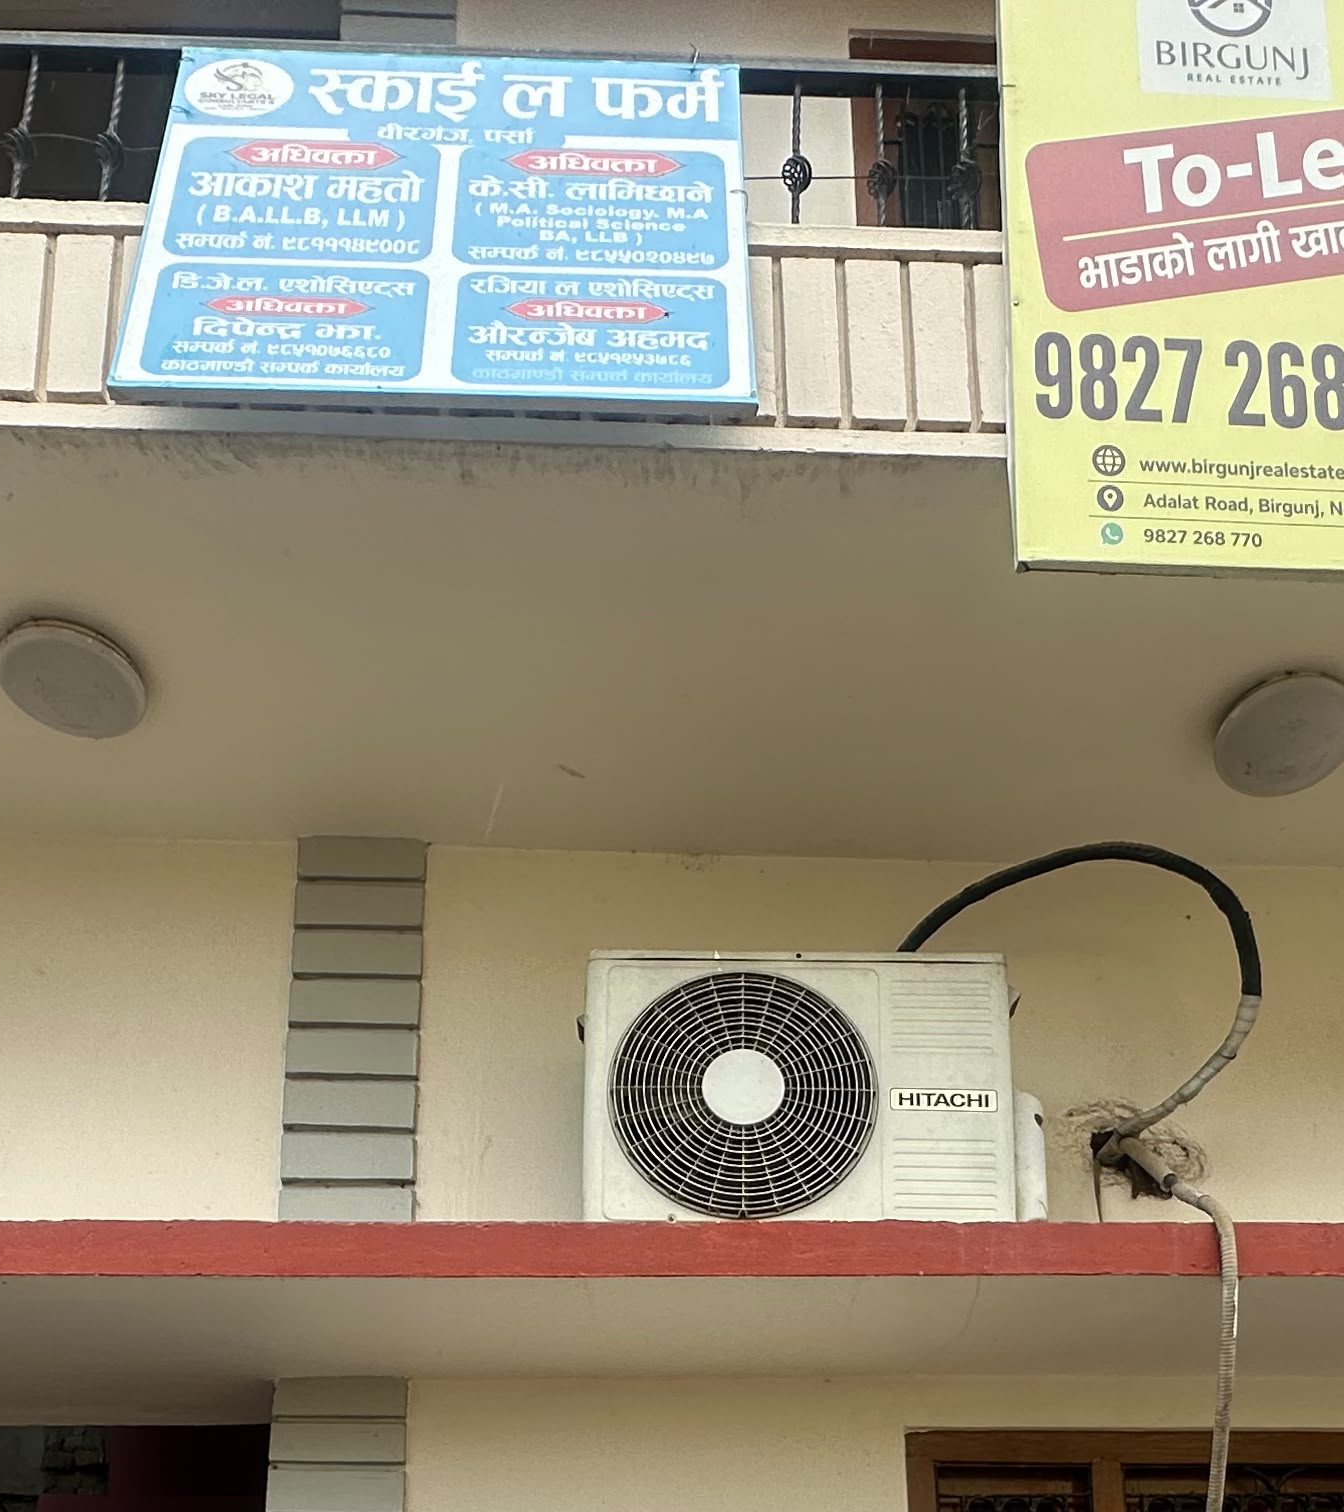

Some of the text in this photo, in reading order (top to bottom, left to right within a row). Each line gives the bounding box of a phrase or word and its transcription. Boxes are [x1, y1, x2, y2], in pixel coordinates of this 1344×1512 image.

[1155, 40, 1310, 81] BIRGUNJ
[1186, 72, 1282, 87] REAL ESTATE
[308, 61, 725, 123] स्काई ल फर्म
[250, 144, 380, 166] अधिवक्ता
[528, 153, 659, 174] अधिवक्ता
[188, 169, 426, 205] आकाश महतो
[337, 207, 390, 228] LLM
[495, 215, 688, 233] Political Science
[174, 230, 249, 250] सम्पर्क
[585, 230, 629, 244] LLB
[467, 242, 540, 261] सम्पर्क
[1077, 231, 1195, 290] भाडाको
[1203, 219, 1282, 273] लागी
[469, 274, 548, 296] रजिया
[553, 279, 582, 297] ल
[224, 296, 349, 315] अधिवक्ता
[526, 301, 648, 320] अधिवक्ता
[191, 315, 307, 340] दिपेन्द्र
[605, 327, 711, 352] अहमद
[1033, 331, 1203, 425] 9827
[1143, 493, 1199, 510] Adalat
[1205, 496, 1254, 515] Road,
[1258, 497, 1325, 519] Birgunj,
[1143, 528, 1263, 548] 9827 268 770
[897, 1091, 991, 1109] HITACHI
